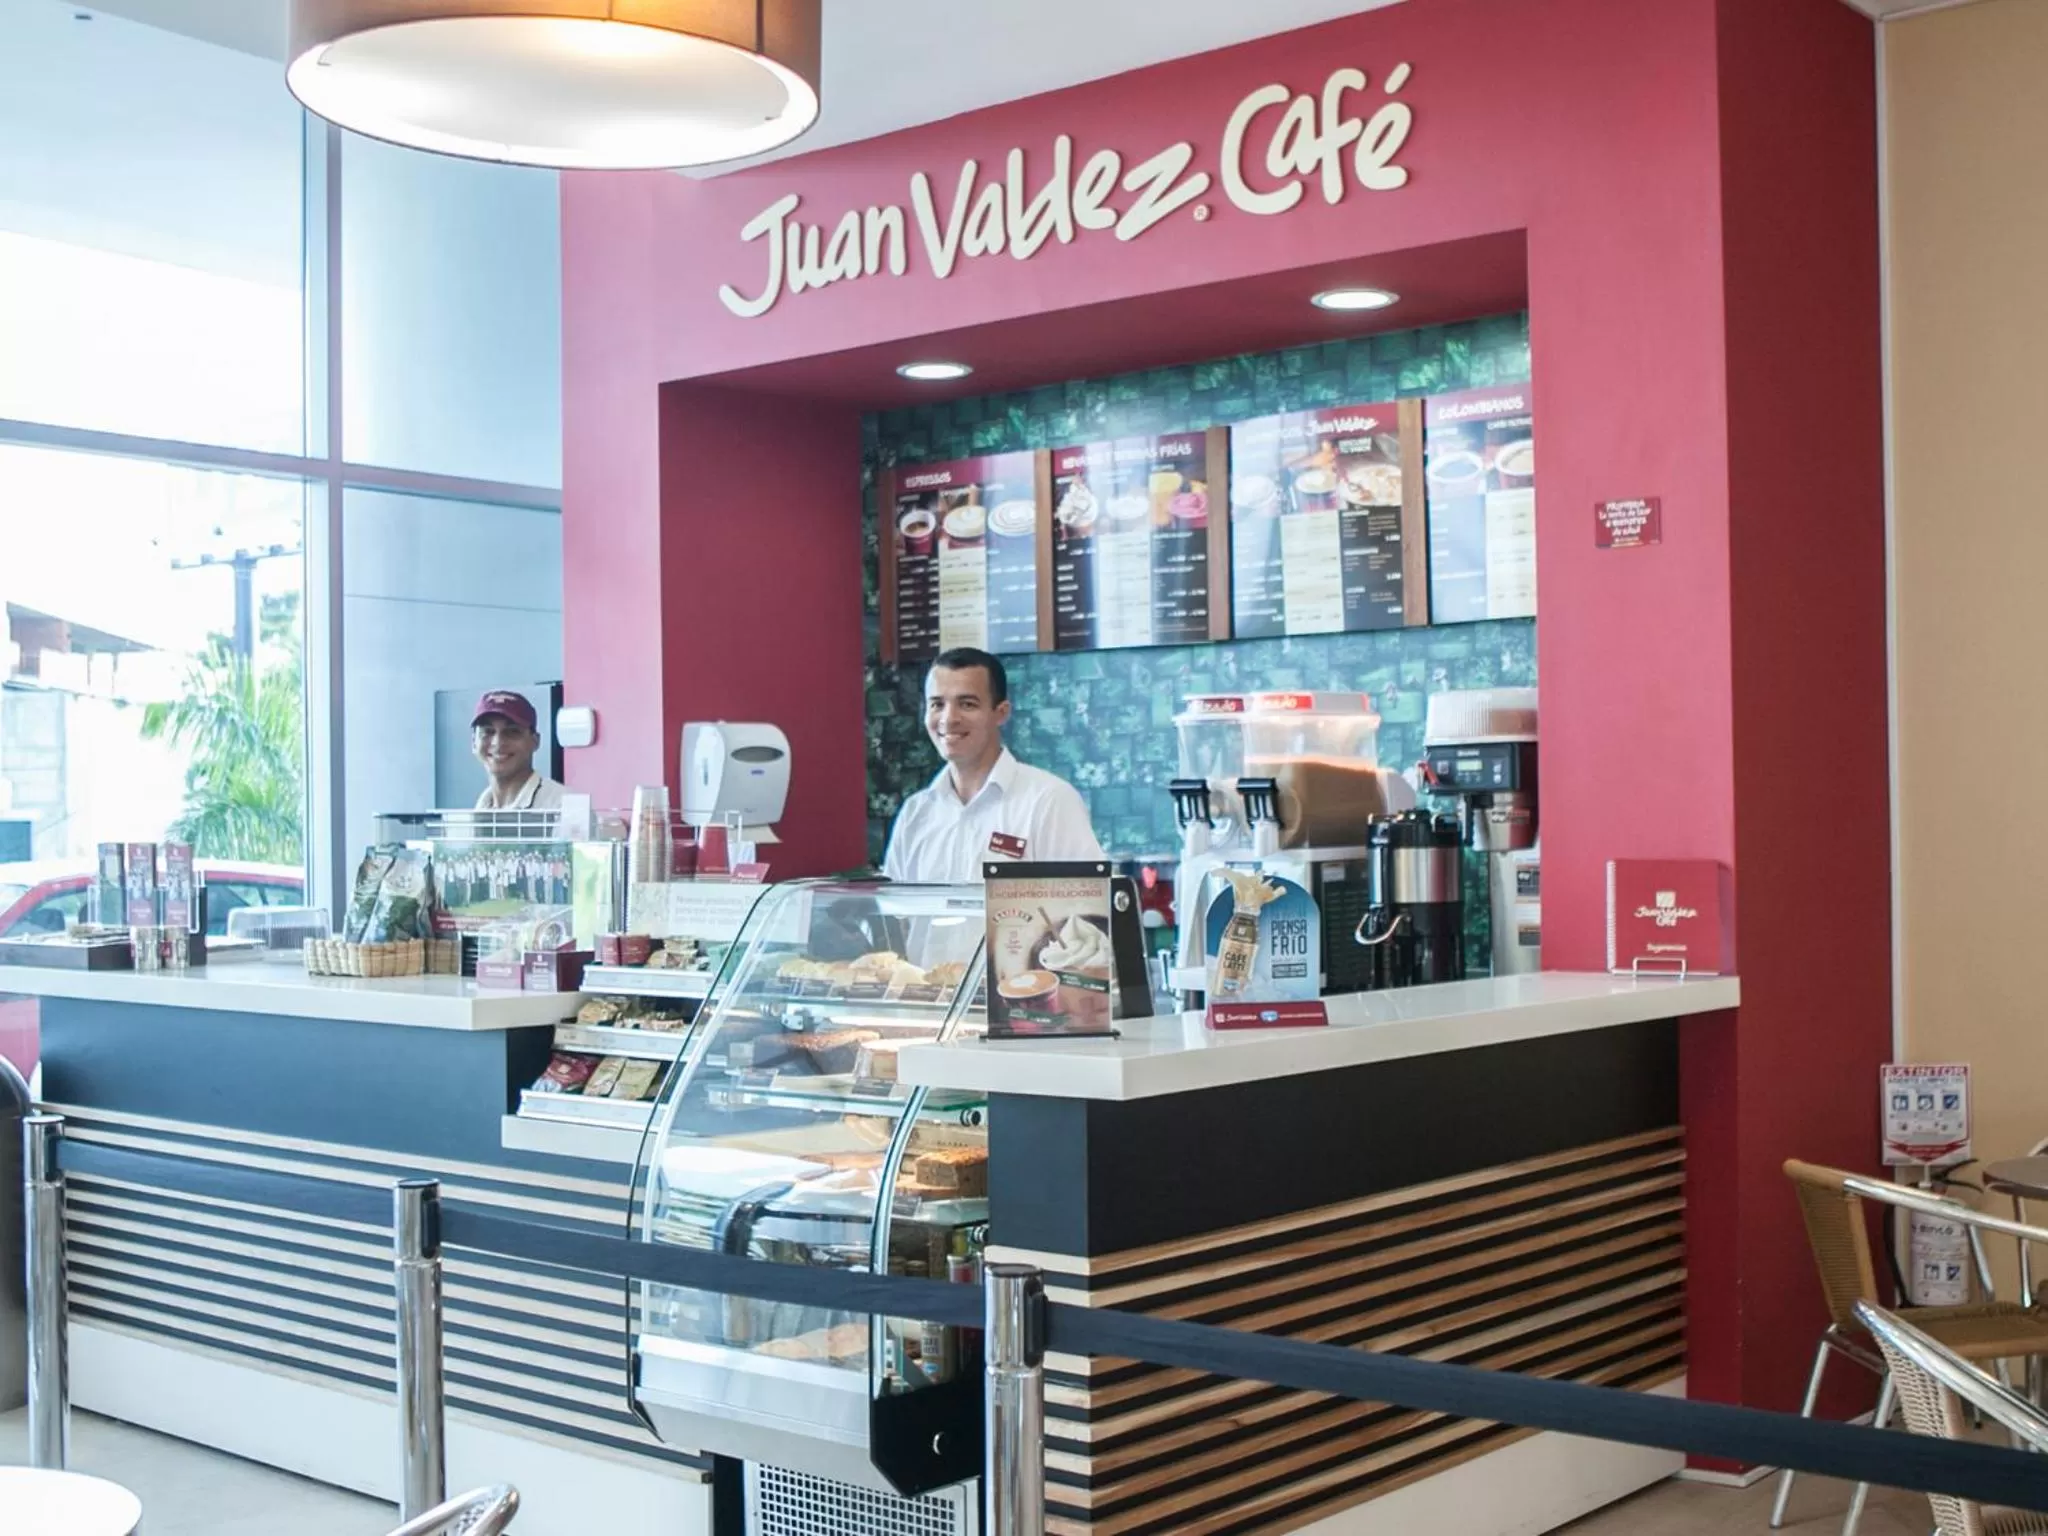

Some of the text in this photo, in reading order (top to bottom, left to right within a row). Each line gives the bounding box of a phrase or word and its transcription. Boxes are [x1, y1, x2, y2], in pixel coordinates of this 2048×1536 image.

[718, 62, 1412, 318] Juan Valdez Café
[1271, 919, 1307, 936] PIENSA
